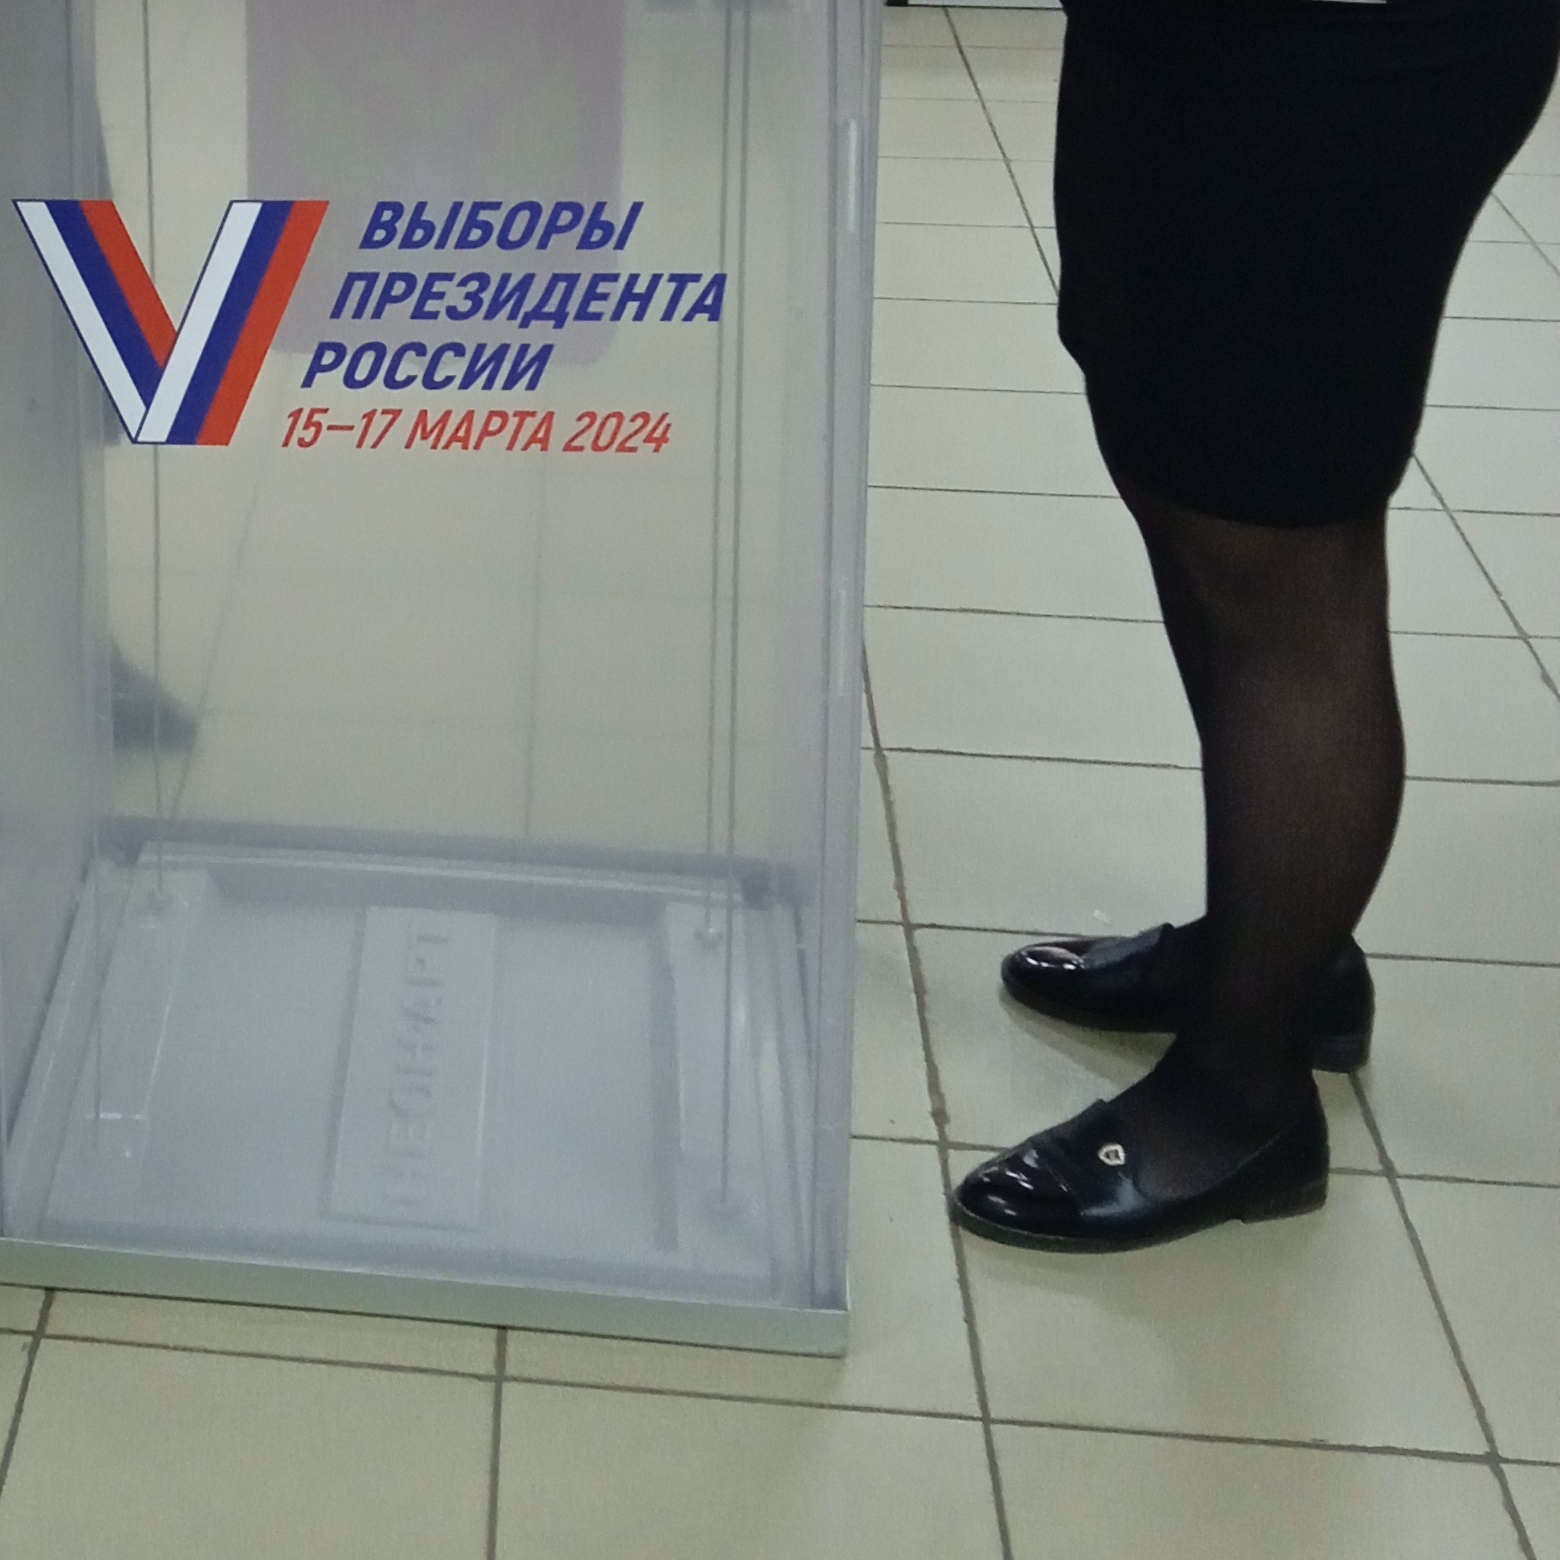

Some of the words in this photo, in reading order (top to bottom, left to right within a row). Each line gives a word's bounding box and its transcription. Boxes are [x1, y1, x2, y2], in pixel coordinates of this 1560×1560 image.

[358, 200, 645, 252] ВЫБОРЫ
[328, 272, 728, 330] ПРЕЗИДЕНТА
[300, 341, 554, 392] РОССИИ
[404, 409, 556, 453] МАРТА
[562, 411, 672, 455] 2024
